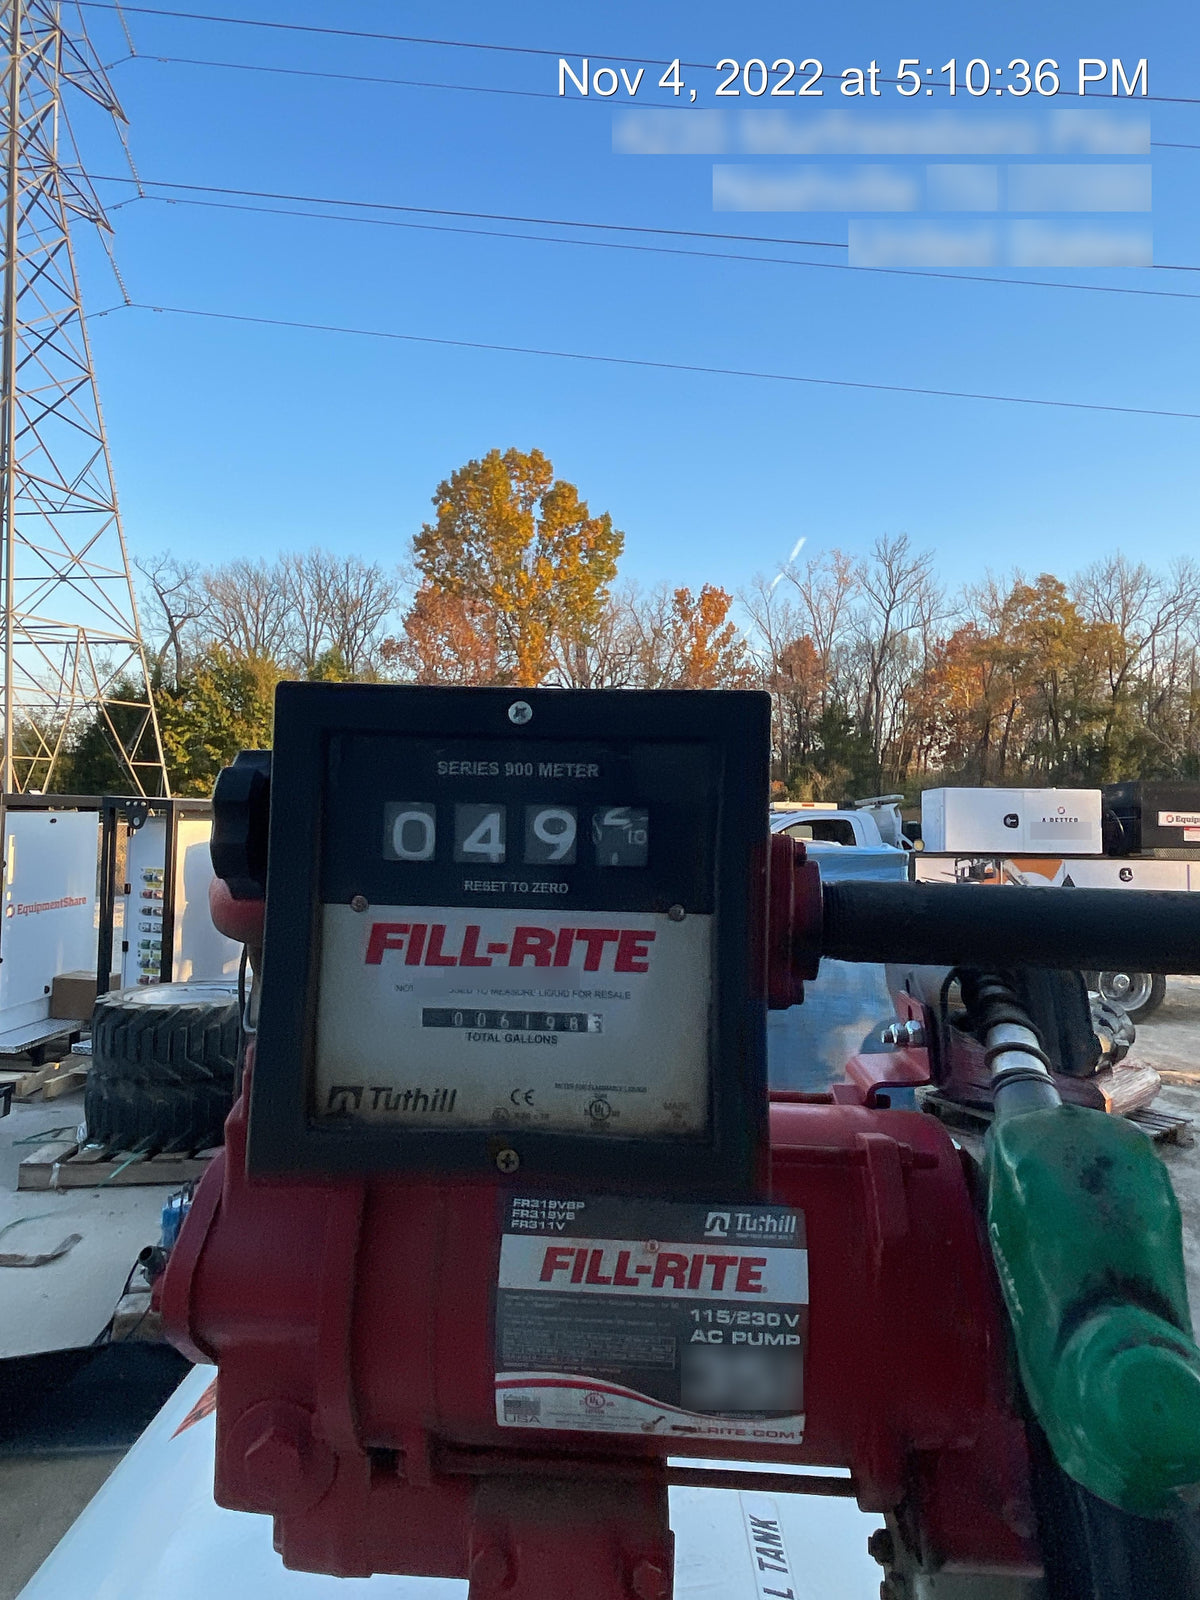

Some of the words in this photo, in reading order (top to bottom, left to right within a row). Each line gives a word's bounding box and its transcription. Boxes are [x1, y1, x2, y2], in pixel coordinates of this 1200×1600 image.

[437, 761, 500, 776] SERIES
[505, 762, 534, 777] 900
[538, 762, 600, 778] METER
[463, 880, 508, 892] RESET
[510, 881, 529, 893] TO
[532, 881, 569, 894] ZERO
[17, 896, 87, 915] EquipmentShare
[364, 922, 656, 973] FILL-RITE
[572, 989, 592, 999] FOR
[594, 989, 632, 1000] RESALE
[466, 1032, 501, 1043] TOTAL
[504, 1032, 558, 1045] GALLONS
[368, 1085, 458, 1114] Tuthill
[511, 1218, 566, 1231] FR311V
[734, 1212, 797, 1233] Tuthill
[539, 1246, 768, 1293] FILL-RITE
[690, 1308, 781, 1328] 115/230
[783, 1313, 800, 1329] V
[690, 1329, 723, 1345] AC
[731, 1330, 801, 1347] PUMP
[671, 1424, 796, 1440] LRITE.COM
[748, 1513, 790, 1575] TANK
